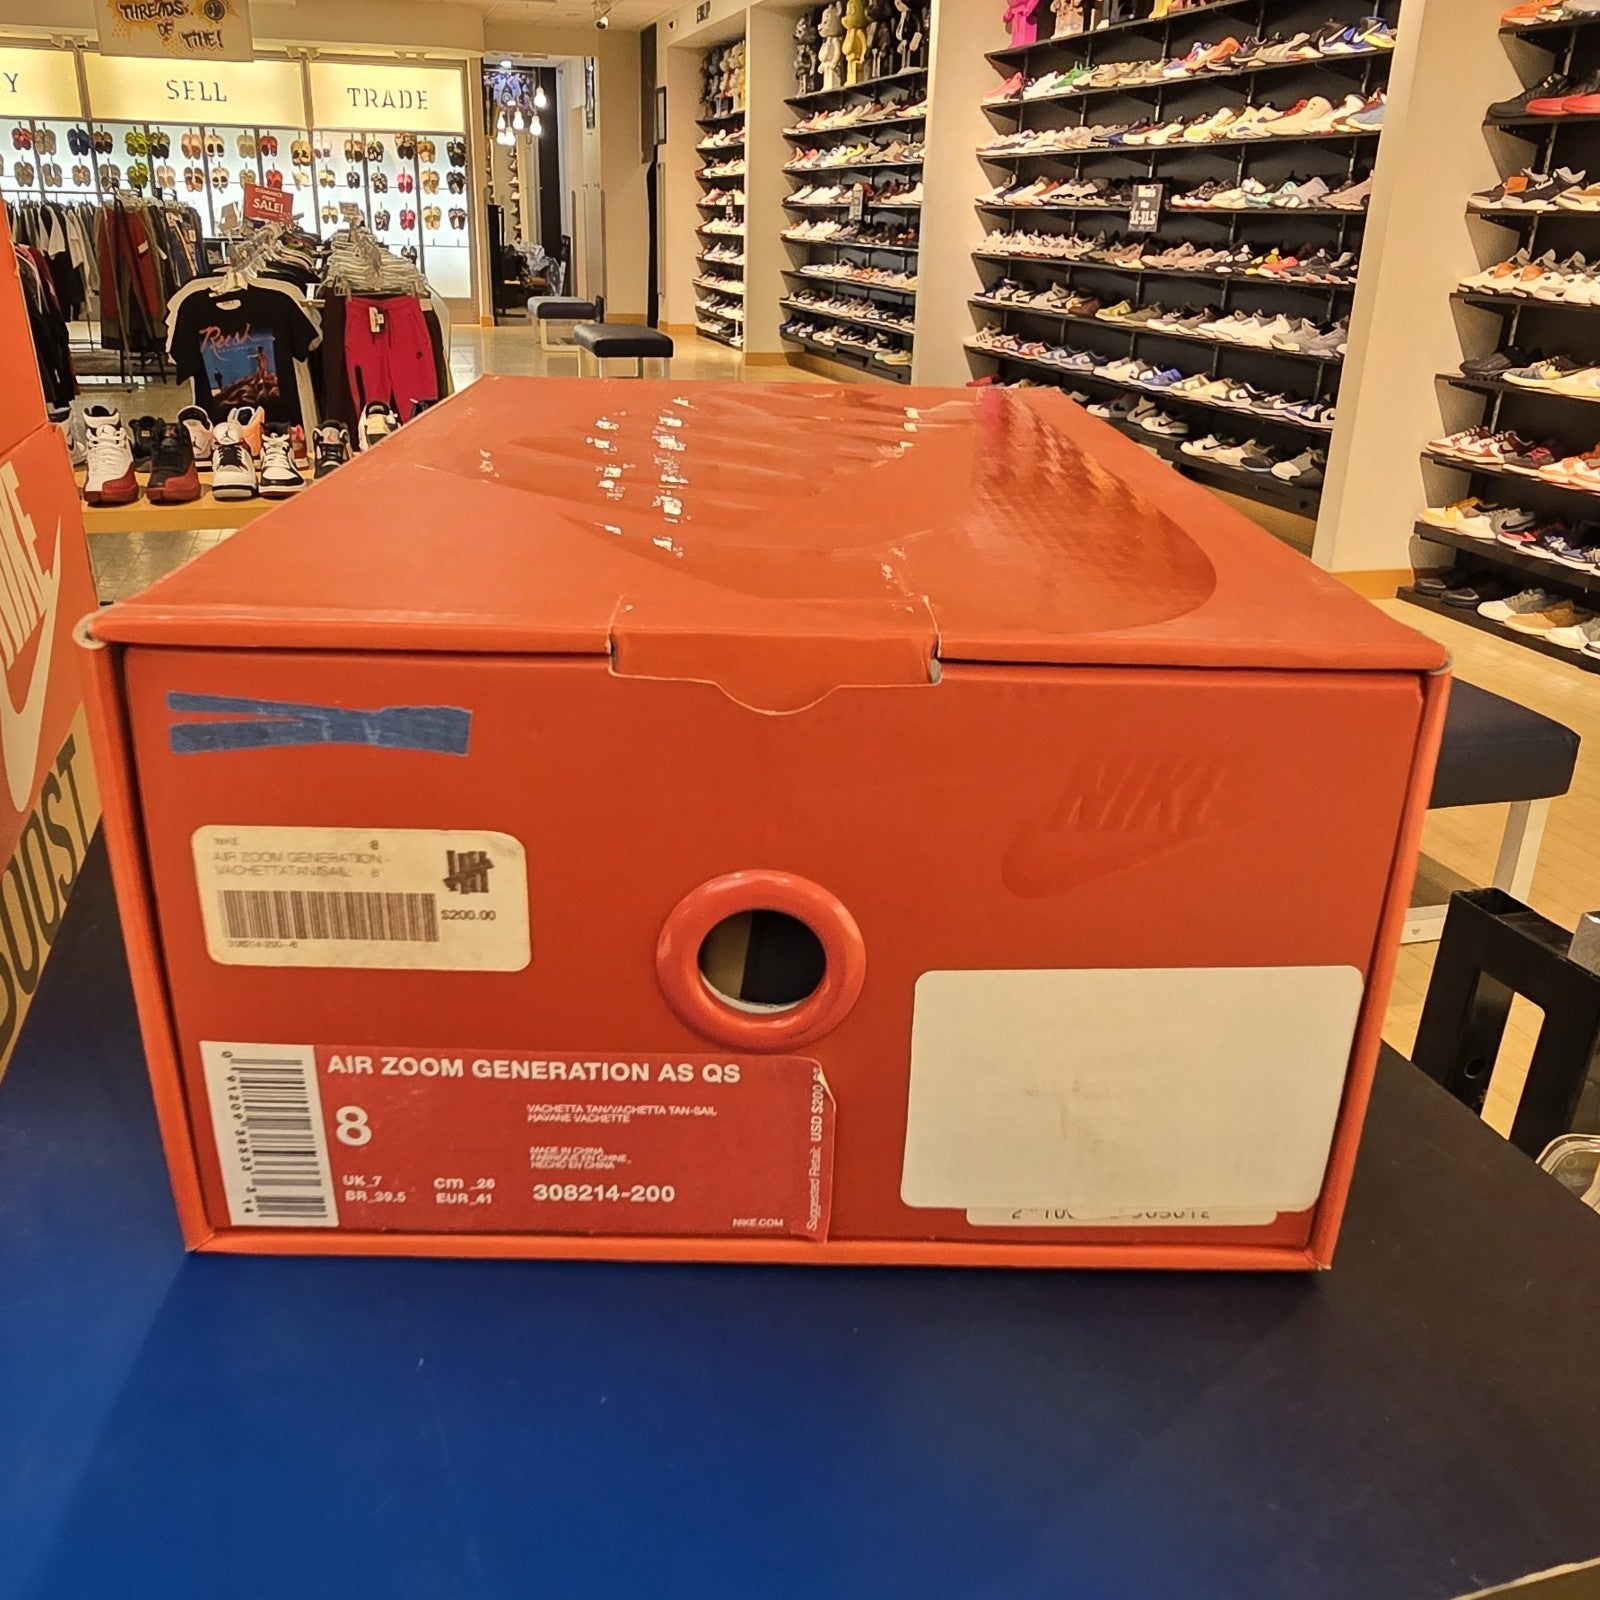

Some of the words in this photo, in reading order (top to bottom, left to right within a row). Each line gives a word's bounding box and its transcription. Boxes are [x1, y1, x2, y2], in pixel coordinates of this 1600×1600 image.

[119, 1, 184, 20] THREADS
[157, 22, 175, 37] OF
[166, 79, 227, 102] SELL
[346, 87, 428, 110] TRADE
[252, 198, 284, 213] SALE!
[1046, 752, 1240, 832] NIKE
[371, 840, 380, 850] 8
[214, 851, 238, 862] AIR
[241, 852, 282, 863] ZOOM
[287, 852, 383, 864] GENERATION
[440, 909, 497, 921] $200.00
[221, 1050, 234, 1059] 0
[327, 1054, 374, 1075] AIR
[380, 1056, 464, 1078] ZOOM
[471, 1059, 650, 1083] GENERATION
[657, 1062, 695, 1083] AS
[702, 1063, 741, 1084] QS
[335, 1104, 373, 1147] 8
[810, 1115, 823, 1142] USD
[529, 1146, 558, 1155] MADE
[573, 1147, 604, 1155] CHINA
[532, 1183, 676, 1204] 308214-200
[732, 1218, 784, 1228] NIKE.COM
